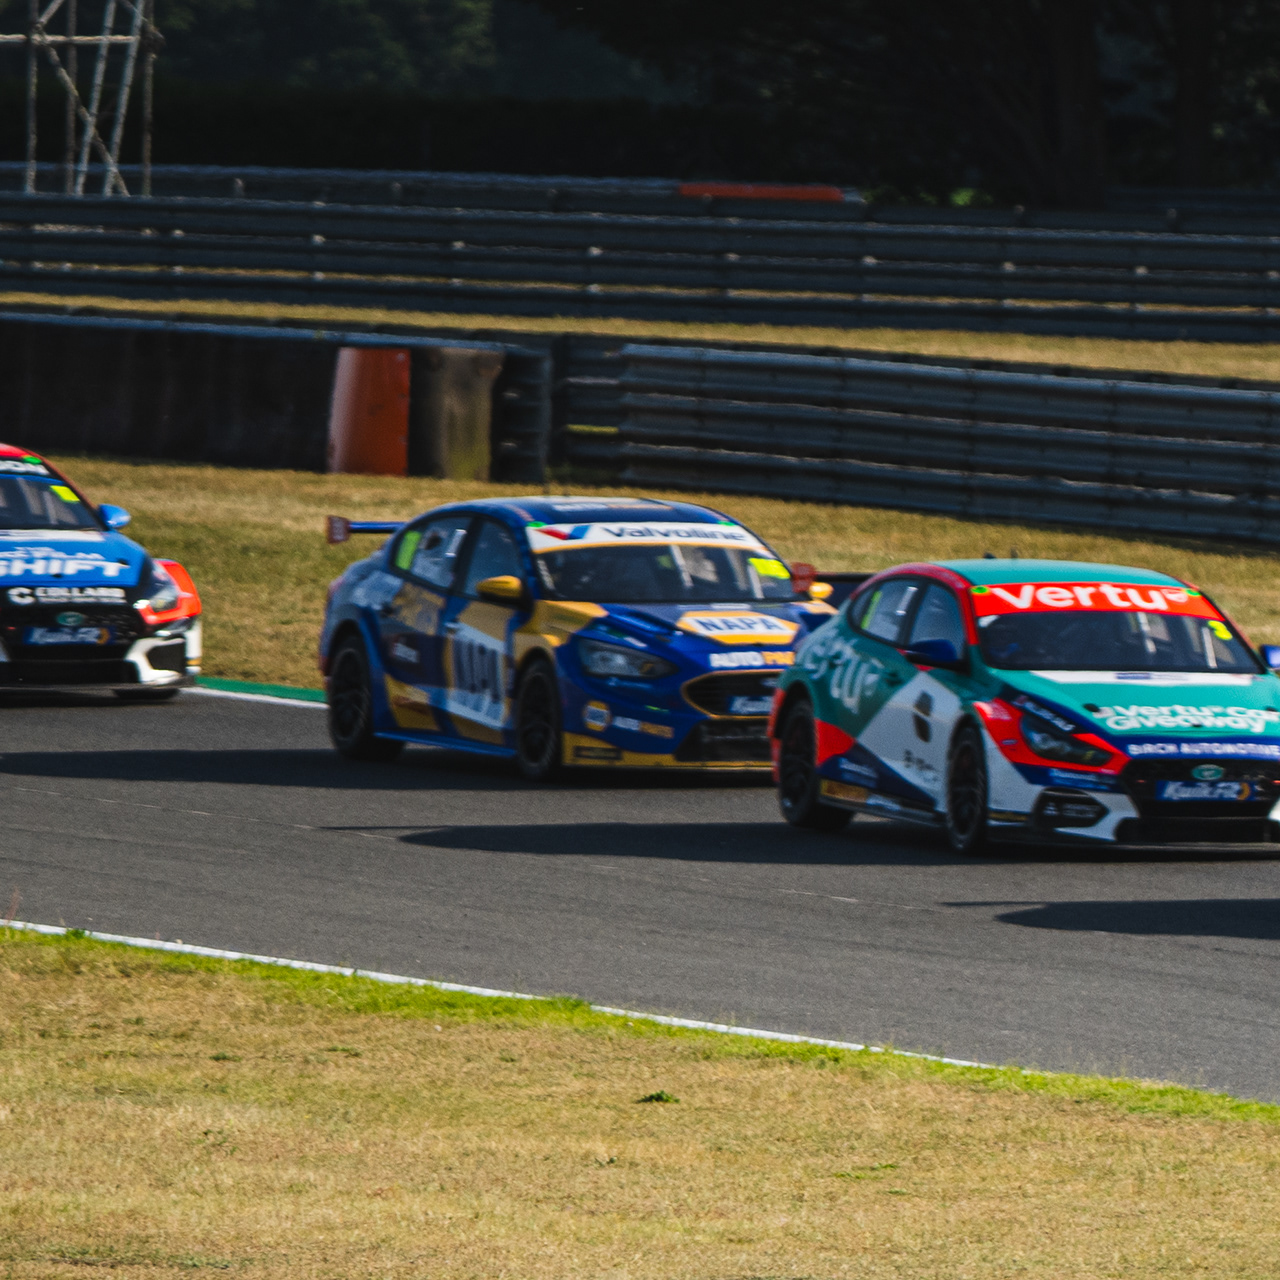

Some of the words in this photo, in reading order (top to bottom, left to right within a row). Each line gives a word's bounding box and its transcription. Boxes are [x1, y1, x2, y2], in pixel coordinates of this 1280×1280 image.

[602, 526, 748, 542] Valvoline
[697, 617, 782, 632] NAPA
[708, 651, 764, 668] AUTO
[1105, 714, 1267, 734] Giveaway
